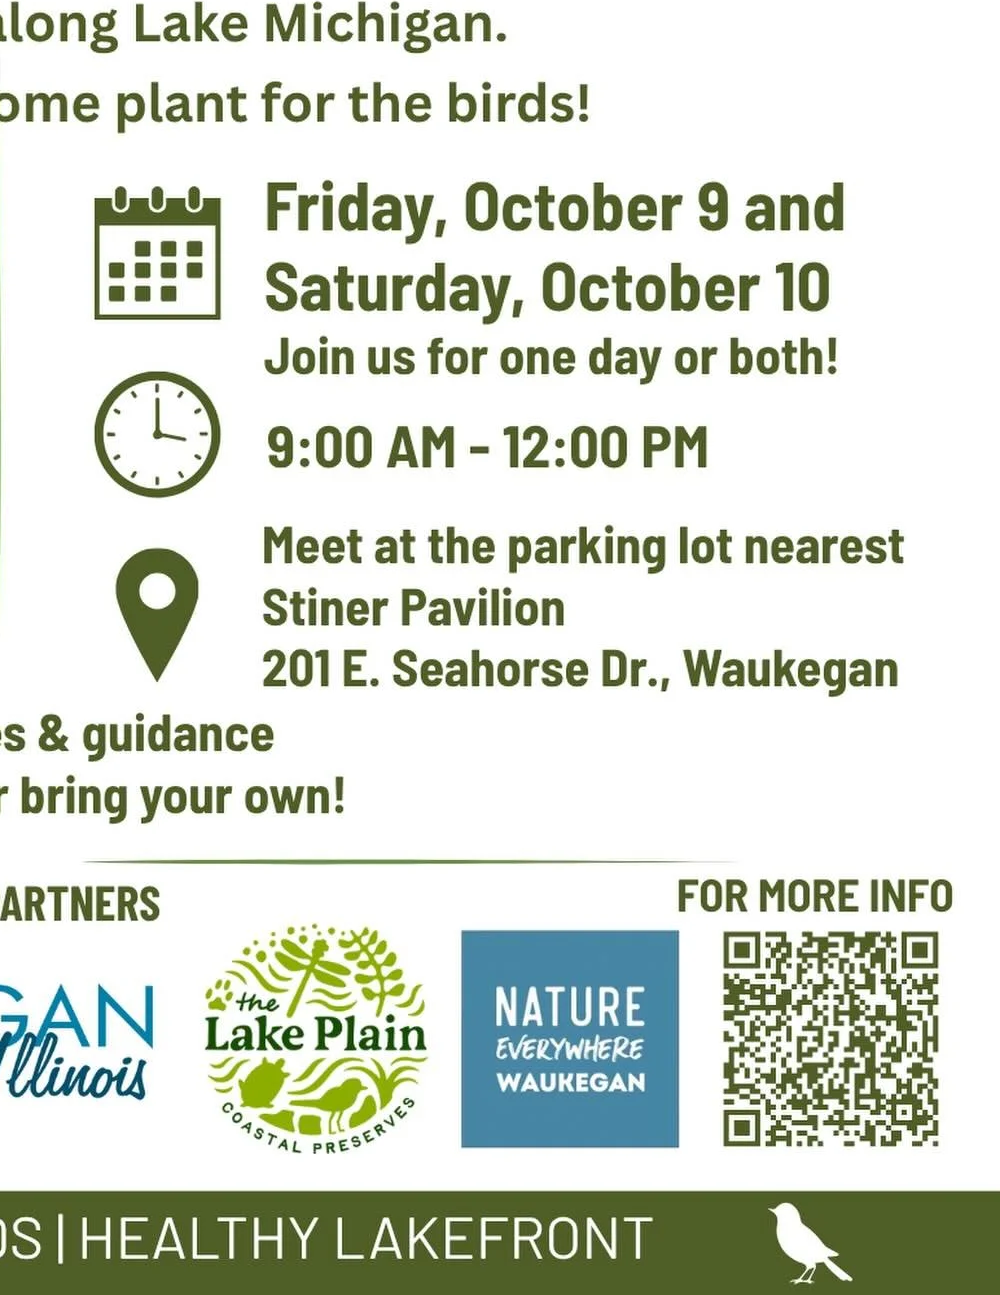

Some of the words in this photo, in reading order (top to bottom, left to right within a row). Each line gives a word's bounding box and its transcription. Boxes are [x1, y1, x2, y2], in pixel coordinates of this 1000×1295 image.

[136, 2, 248, 42] Lake
[266, 1, 506, 53] Michigan.
[118, 82, 247, 134] plant
[261, 81, 335, 123] for
[348, 82, 431, 122] the
[449, 82, 588, 123] birds!
[267, 180, 446, 244] Friday,
[466, 182, 683, 231] October
[698, 181, 728, 231] 9
[745, 182, 844, 231] and
[266, 262, 523, 325] Saturday,
[543, 262, 760, 312] October
[776, 262, 829, 312] 10
[264, 336, 354, 375] Join
[368, 347, 415, 375] us
[427, 338, 488, 375] for
[500, 347, 575, 375] one
[589, 337, 662, 385] day
[675, 347, 718, 375] or
[730, 337, 837, 375] both!
[268, 426, 372, 468] 9:00
[387, 426, 454, 468] AM
[504, 426, 627, 468] 12:00
[644, 426, 707, 468] PM
[264, 526, 362, 564] Meet
[375, 529, 416, 564] at
[428, 526, 495, 564] the
[509, 525, 665, 574] parking
[680, 526, 732, 564] lot
[746, 529, 904, 564] nearest
[263, 587, 389, 626] Stiner
[402, 587, 564, 626] Pavilion
[263, 649, 329, 687] 201
[344, 649, 379, 687] E.
[393, 649, 588, 687] Seahorse
[602, 649, 669, 692] Dr.,
[683, 649, 898, 697] Waukegan
[39, 714, 69, 752] &
[83, 713, 274, 762] guidance
[22, 775, 127, 824] bring
[140, 786, 232, 824] your
[245, 776, 343, 814] own!
[679, 879, 747, 912] FOR
[760, 879, 859, 912] MORE
[871, 879, 952, 912] INFO
[235, 992, 280, 1012] the
[496, 986, 644, 1026] NATURE
[205, 1015, 305, 1052] Lake
[314, 1014, 427, 1052] Plain
[496, 1035, 643, 1062] EVERYWHERE
[497, 1073, 645, 1092] WAUKEGAN
[222, 1102, 302, 1153] COASTAL
[313, 1097, 415, 1154] PRESERVES
[82, 1217, 318, 1259] HEALTHY
[337, 1217, 653, 1259] LAKEFRONT
